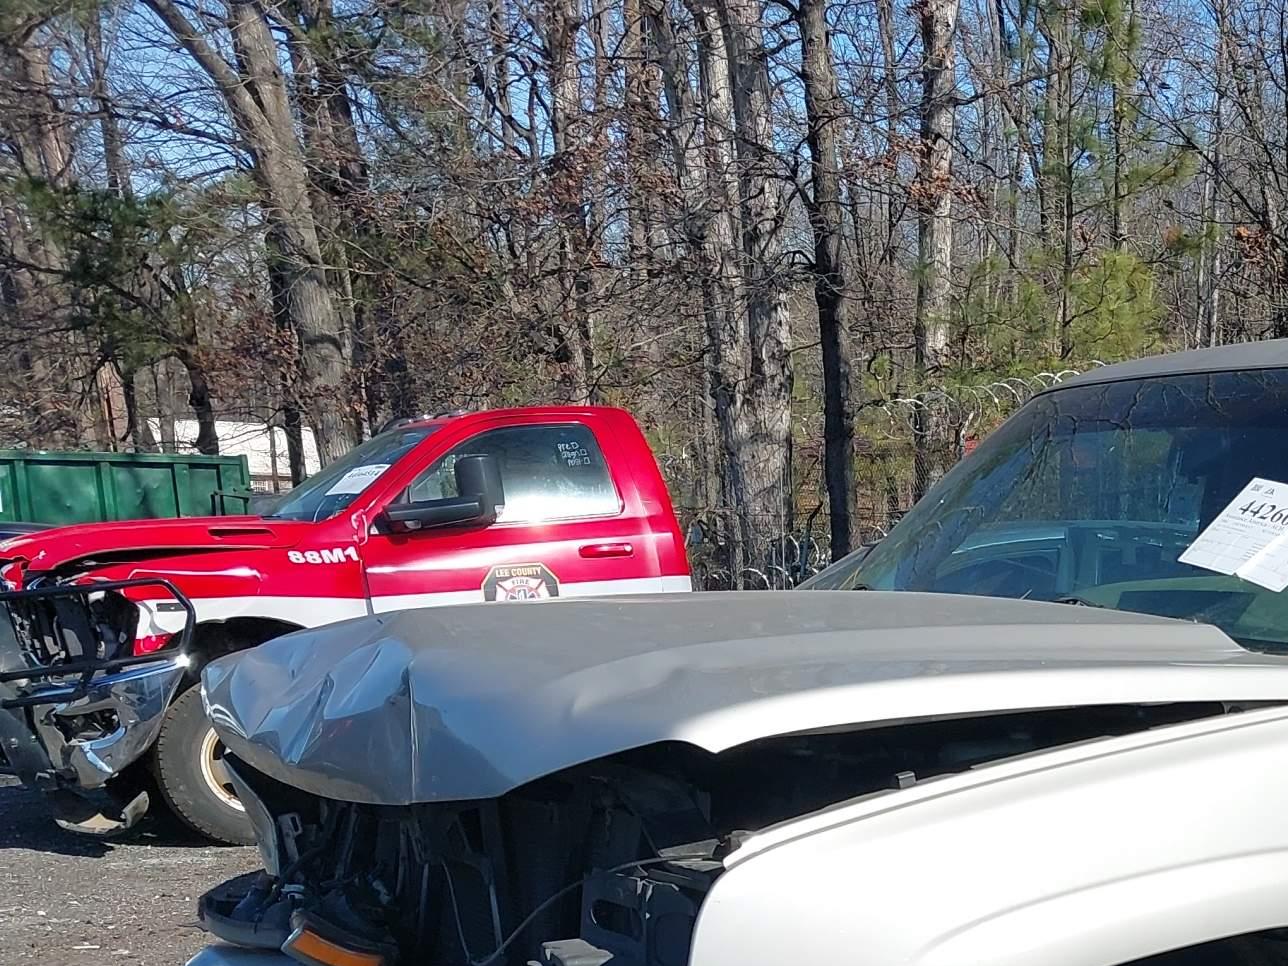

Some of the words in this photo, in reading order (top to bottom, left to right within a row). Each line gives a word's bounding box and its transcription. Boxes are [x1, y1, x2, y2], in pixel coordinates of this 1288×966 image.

[287, 546, 359, 564] 88M1
[495, 569, 510, 577] LEE
[511, 567, 541, 577] COUNTY
